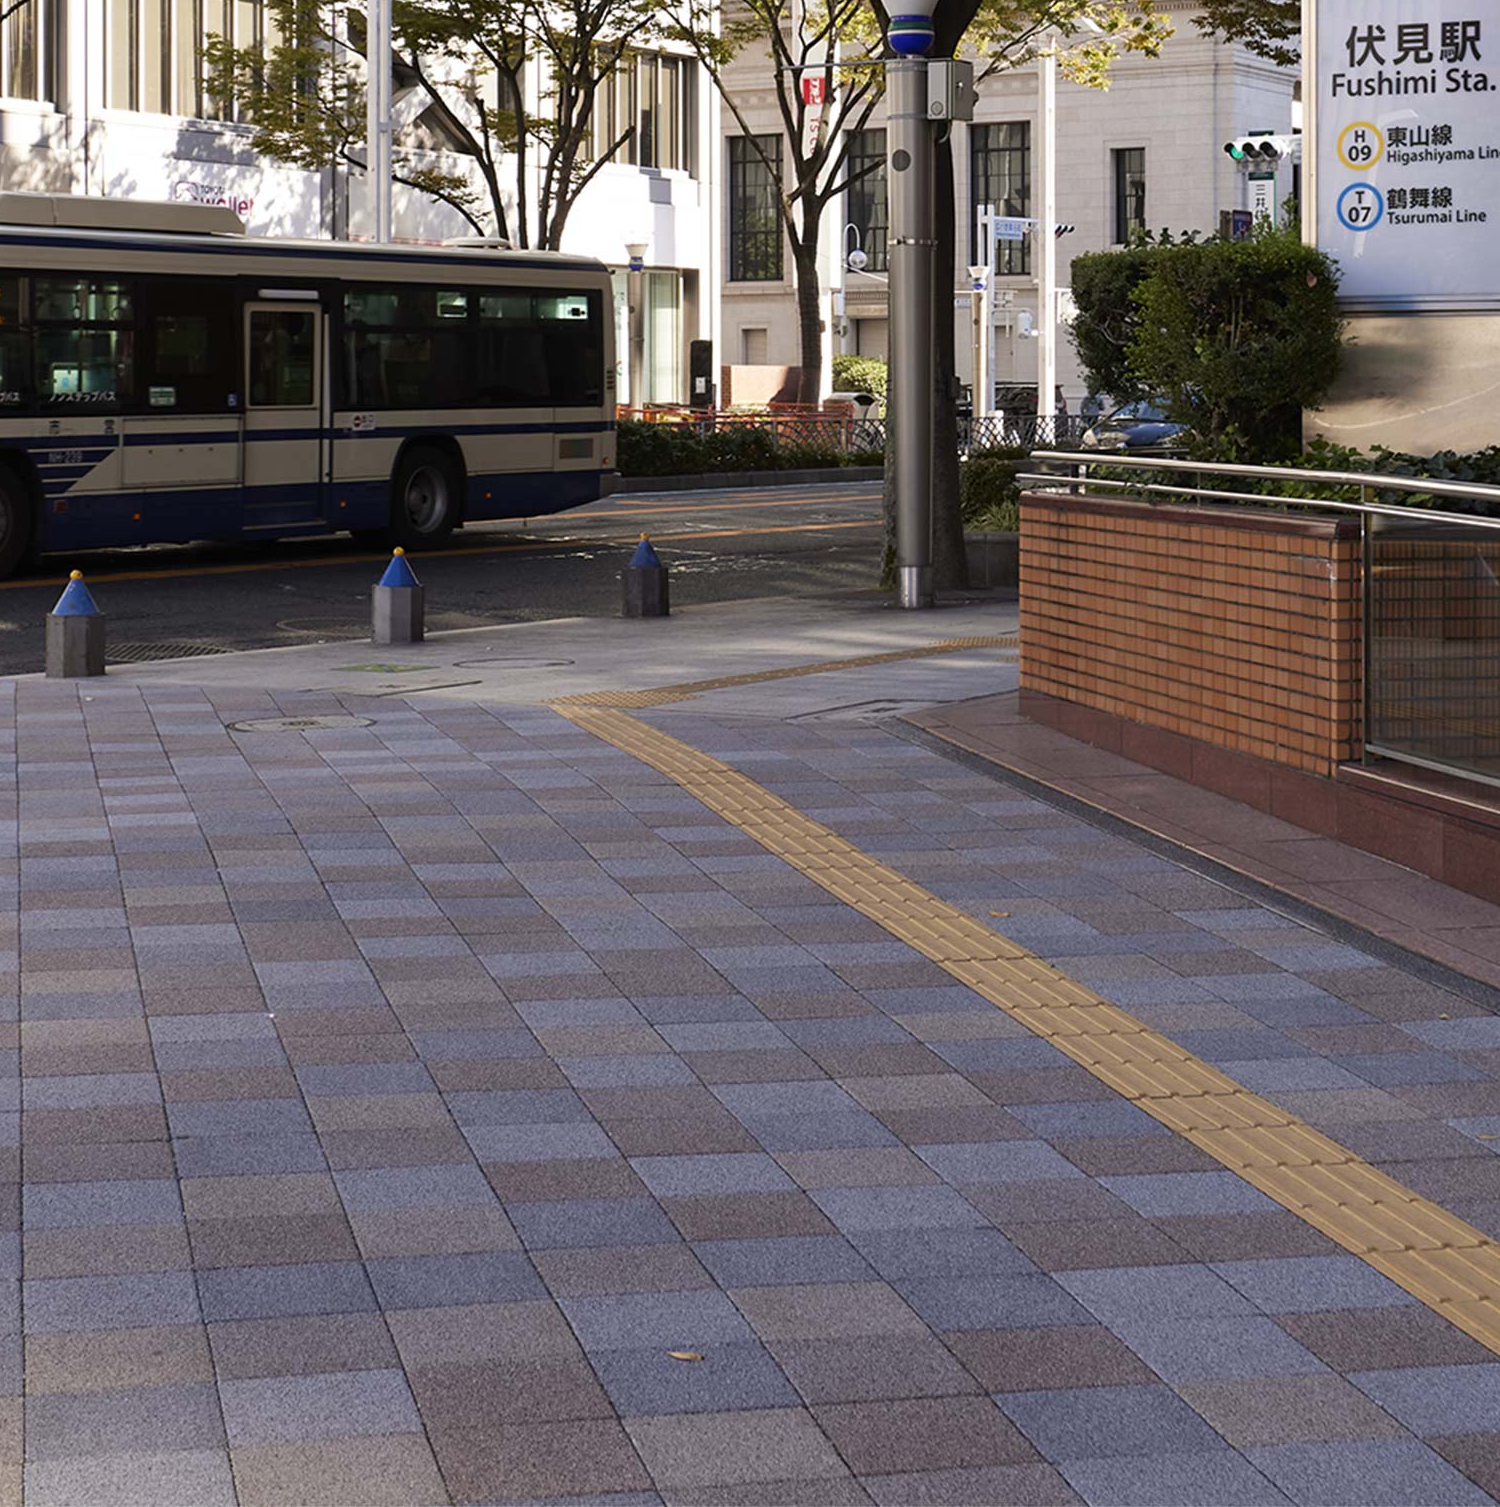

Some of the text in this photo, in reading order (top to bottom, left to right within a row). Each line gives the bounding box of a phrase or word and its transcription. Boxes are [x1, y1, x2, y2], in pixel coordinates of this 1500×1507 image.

[1346, 20, 1482, 68] 伏見駅
[1331, 67, 1497, 98] Fushimi Sta.
[1354, 130, 1365, 143] H
[1386, 124, 1453, 148] 東山線
[1348, 145, 1372, 162] 09
[1386, 148, 1475, 166] Higashiyama
[1354, 191, 1365, 204] T
[1386, 187, 1453, 210] 鶴舞線
[1348, 206, 1371, 223] 07
[1386, 208, 1487, 225] Tsurumai Line
[50, 391, 117, 403] ノンステップバス
